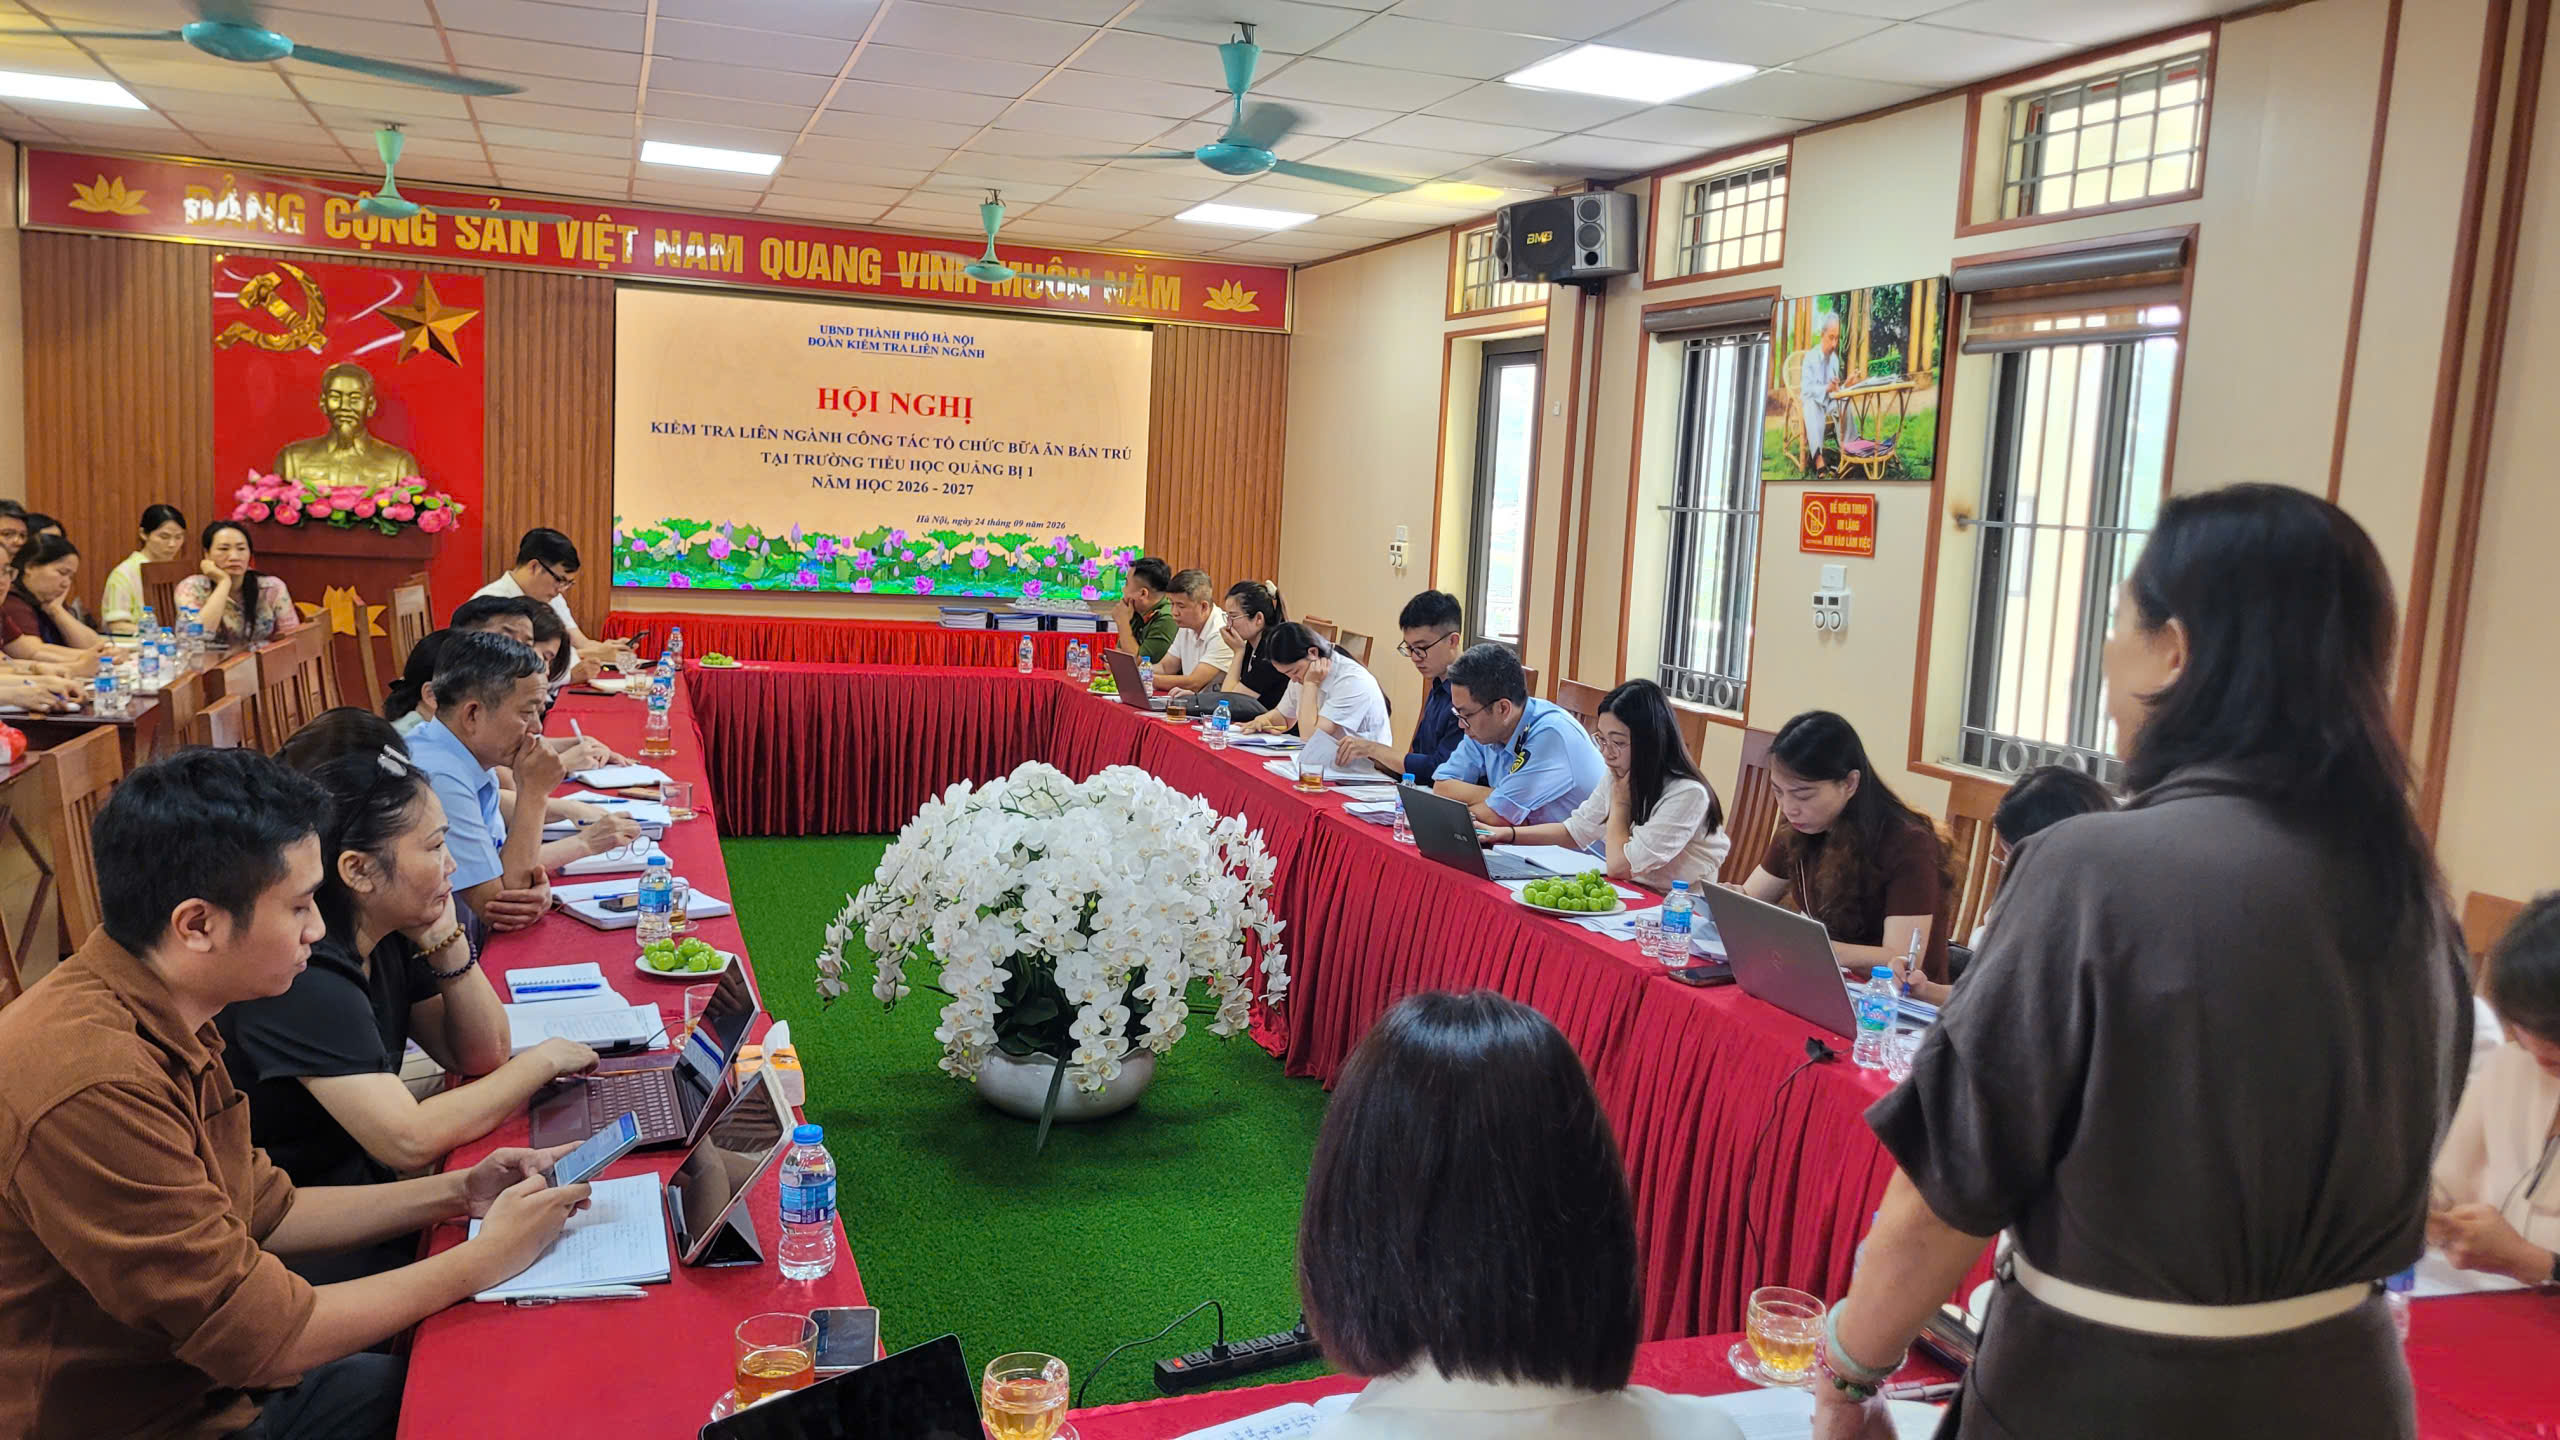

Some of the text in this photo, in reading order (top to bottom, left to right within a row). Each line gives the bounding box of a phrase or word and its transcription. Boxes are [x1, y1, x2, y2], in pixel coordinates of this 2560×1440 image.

[183, 173, 305, 235] ĐẢNG
[455, 198, 539, 256] SẢN
[556, 213, 639, 270] VIỆT
[654, 228, 744, 274] NAM
[760, 237, 882, 287] QUANG
[898, 251, 977, 294] VINH
[1104, 264, 1182, 312] NĂM
[808, 336, 843, 349] ĐOÀN
[883, 342, 907, 353] TRA
[910, 343, 939, 355] LIÊN
[942, 345, 985, 358] NGÀNH
[820, 325, 854, 337] UBND
[857, 327, 900, 341] THÀNH
[932, 331, 949, 344] HÀ
[953, 334, 975, 347] NỘI
[816, 386, 974, 425] HỘI NGHỊ
[651, 419, 696, 436] KIỂM
[701, 424, 735, 438] TRA
[739, 424, 778, 440] LIÊN
[783, 427, 842, 444] NGÀNH
[847, 430, 893, 447] CÔNG
[897, 433, 930, 449] TÁC
[959, 437, 1004, 453] CHỨC
[1008, 440, 1040, 455] BỮA
[1043, 441, 1064, 457] ĂN
[1068, 443, 1098, 459] BÁN
[1102, 445, 1132, 460] TRÚ
[760, 451, 789, 467] TẠI
[793, 453, 864, 469] TRƯỜNG
[910, 459, 944, 475] HỌC
[948, 459, 1004, 476] QUẢNG
[1008, 465, 1023, 480] BỊ
[1028, 466, 1033, 478] 1
[811, 474, 851, 490] NĂM
[855, 479, 893, 494] HỌC
[896, 480, 929, 493] 2026
[942, 482, 974, 496] 2027
[916, 514, 930, 524] Hà
[932, 514, 950, 526] Nội,
[952, 516, 974, 528] ngày
[975, 517, 986, 527] 24
[987, 517, 1012, 529] tháng
[1013, 519, 1024, 529] 09
[1046, 520, 1066, 530] 2026
